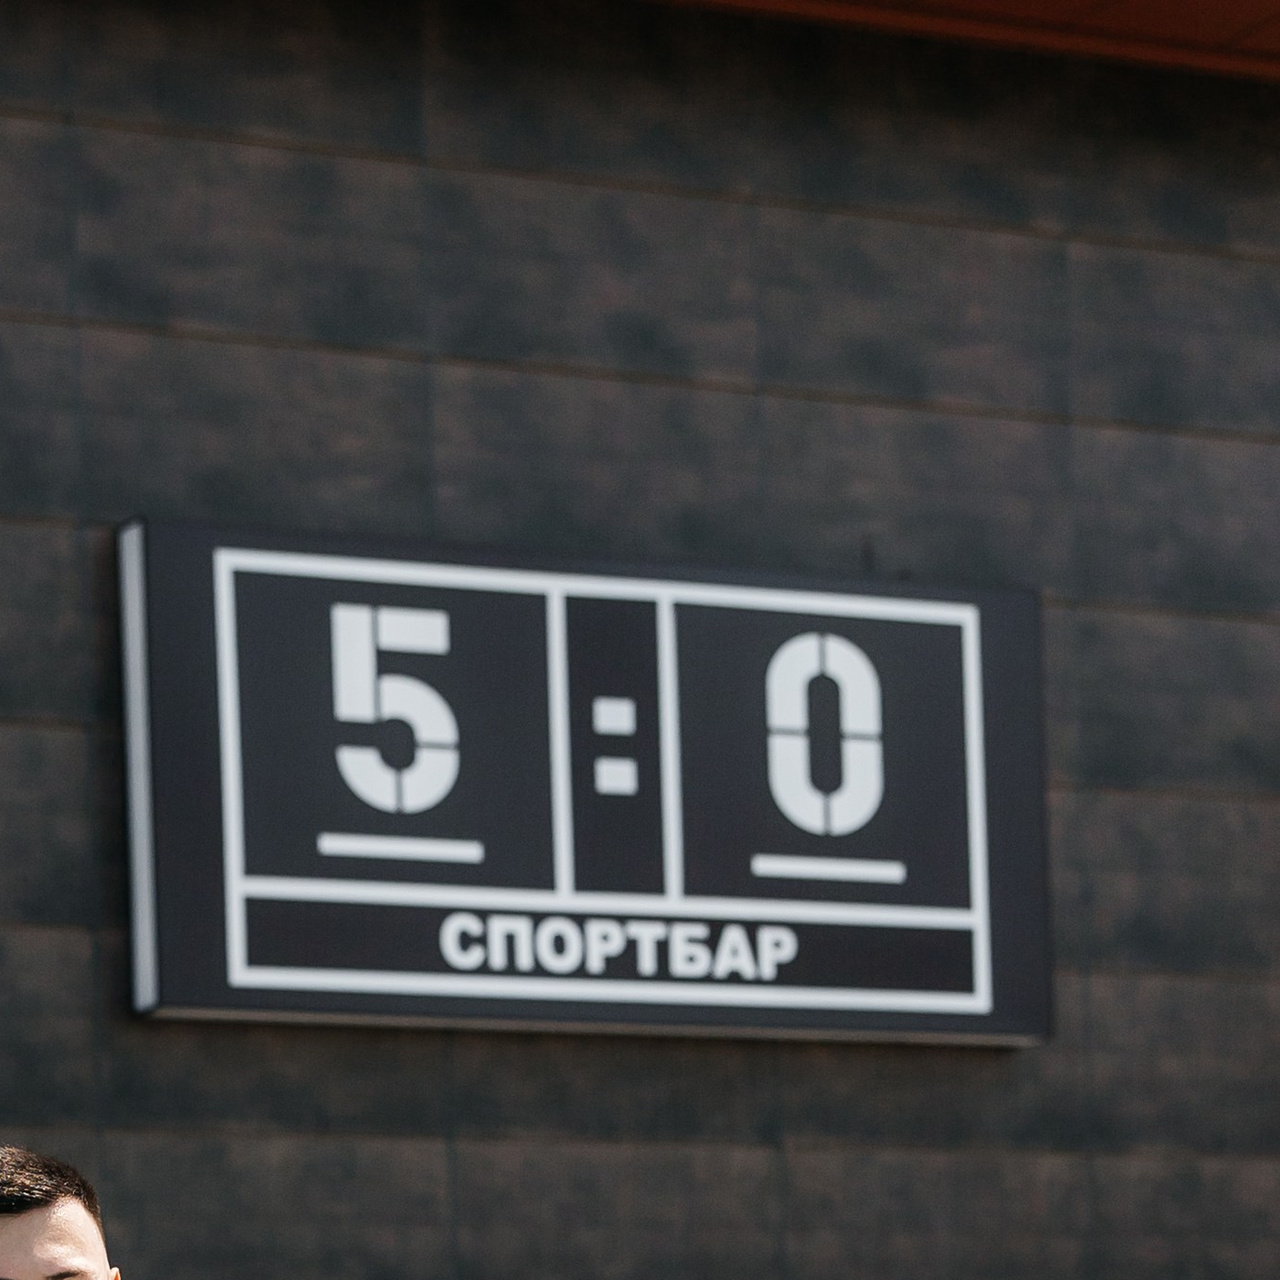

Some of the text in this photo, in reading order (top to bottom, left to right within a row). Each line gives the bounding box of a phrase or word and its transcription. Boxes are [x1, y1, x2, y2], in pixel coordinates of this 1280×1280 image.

[331, 604, 460, 814] 5
[765, 632, 885, 836] 0
[439, 911, 798, 982] СПОРТБАР
